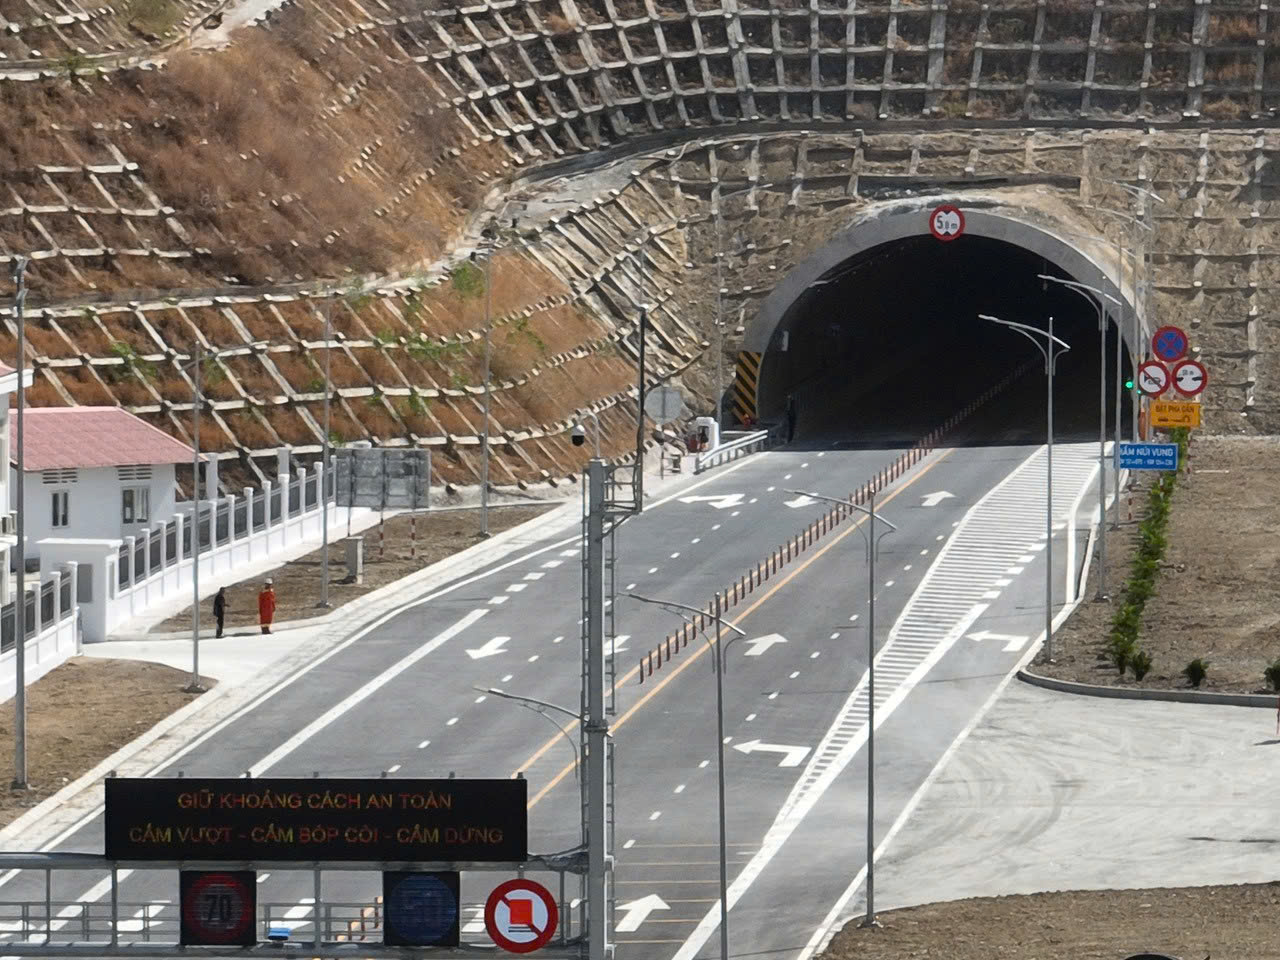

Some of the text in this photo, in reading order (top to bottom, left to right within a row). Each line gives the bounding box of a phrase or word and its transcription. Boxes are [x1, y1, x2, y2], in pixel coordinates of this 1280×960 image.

[177, 788, 452, 810] GIỮ KHOẢNG CÁCH AN TOÀN
